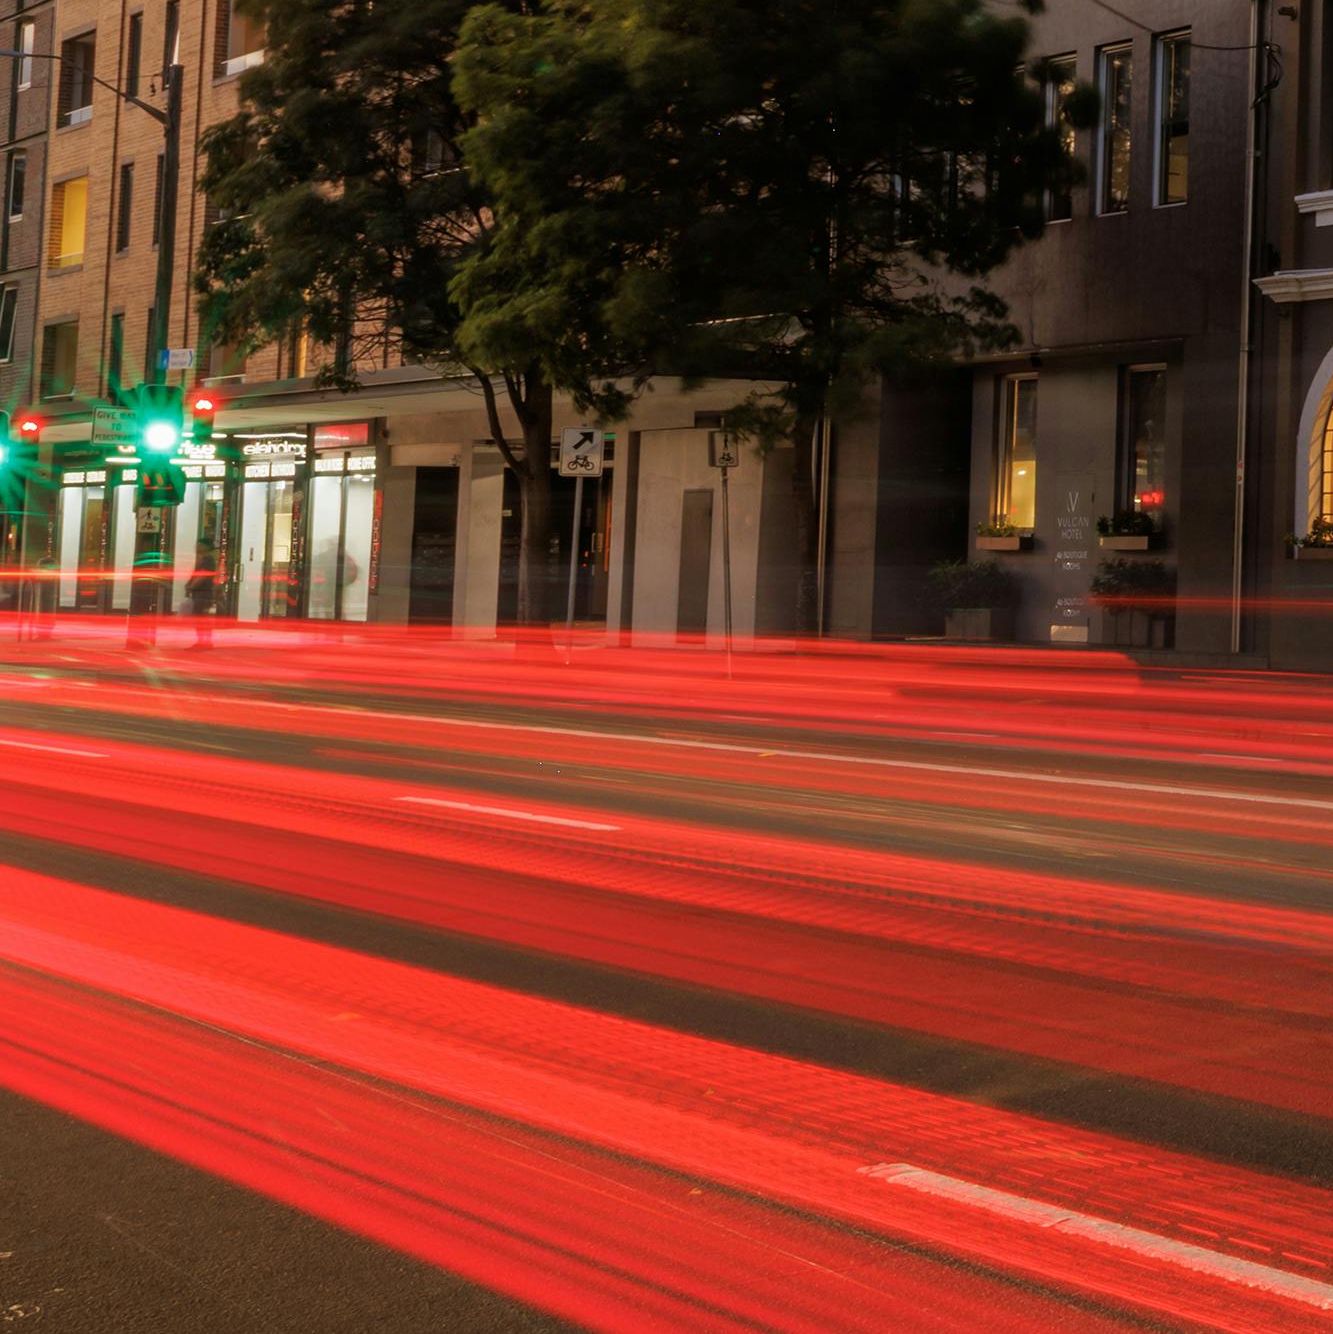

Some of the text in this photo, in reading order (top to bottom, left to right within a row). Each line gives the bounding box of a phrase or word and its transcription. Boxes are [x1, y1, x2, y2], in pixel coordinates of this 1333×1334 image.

[97, 411, 117, 420] GIVE
[112, 423, 123, 431] TO
[1057, 517, 1090, 528] VULCAN
[1061, 528, 1084, 540] HOTEL
